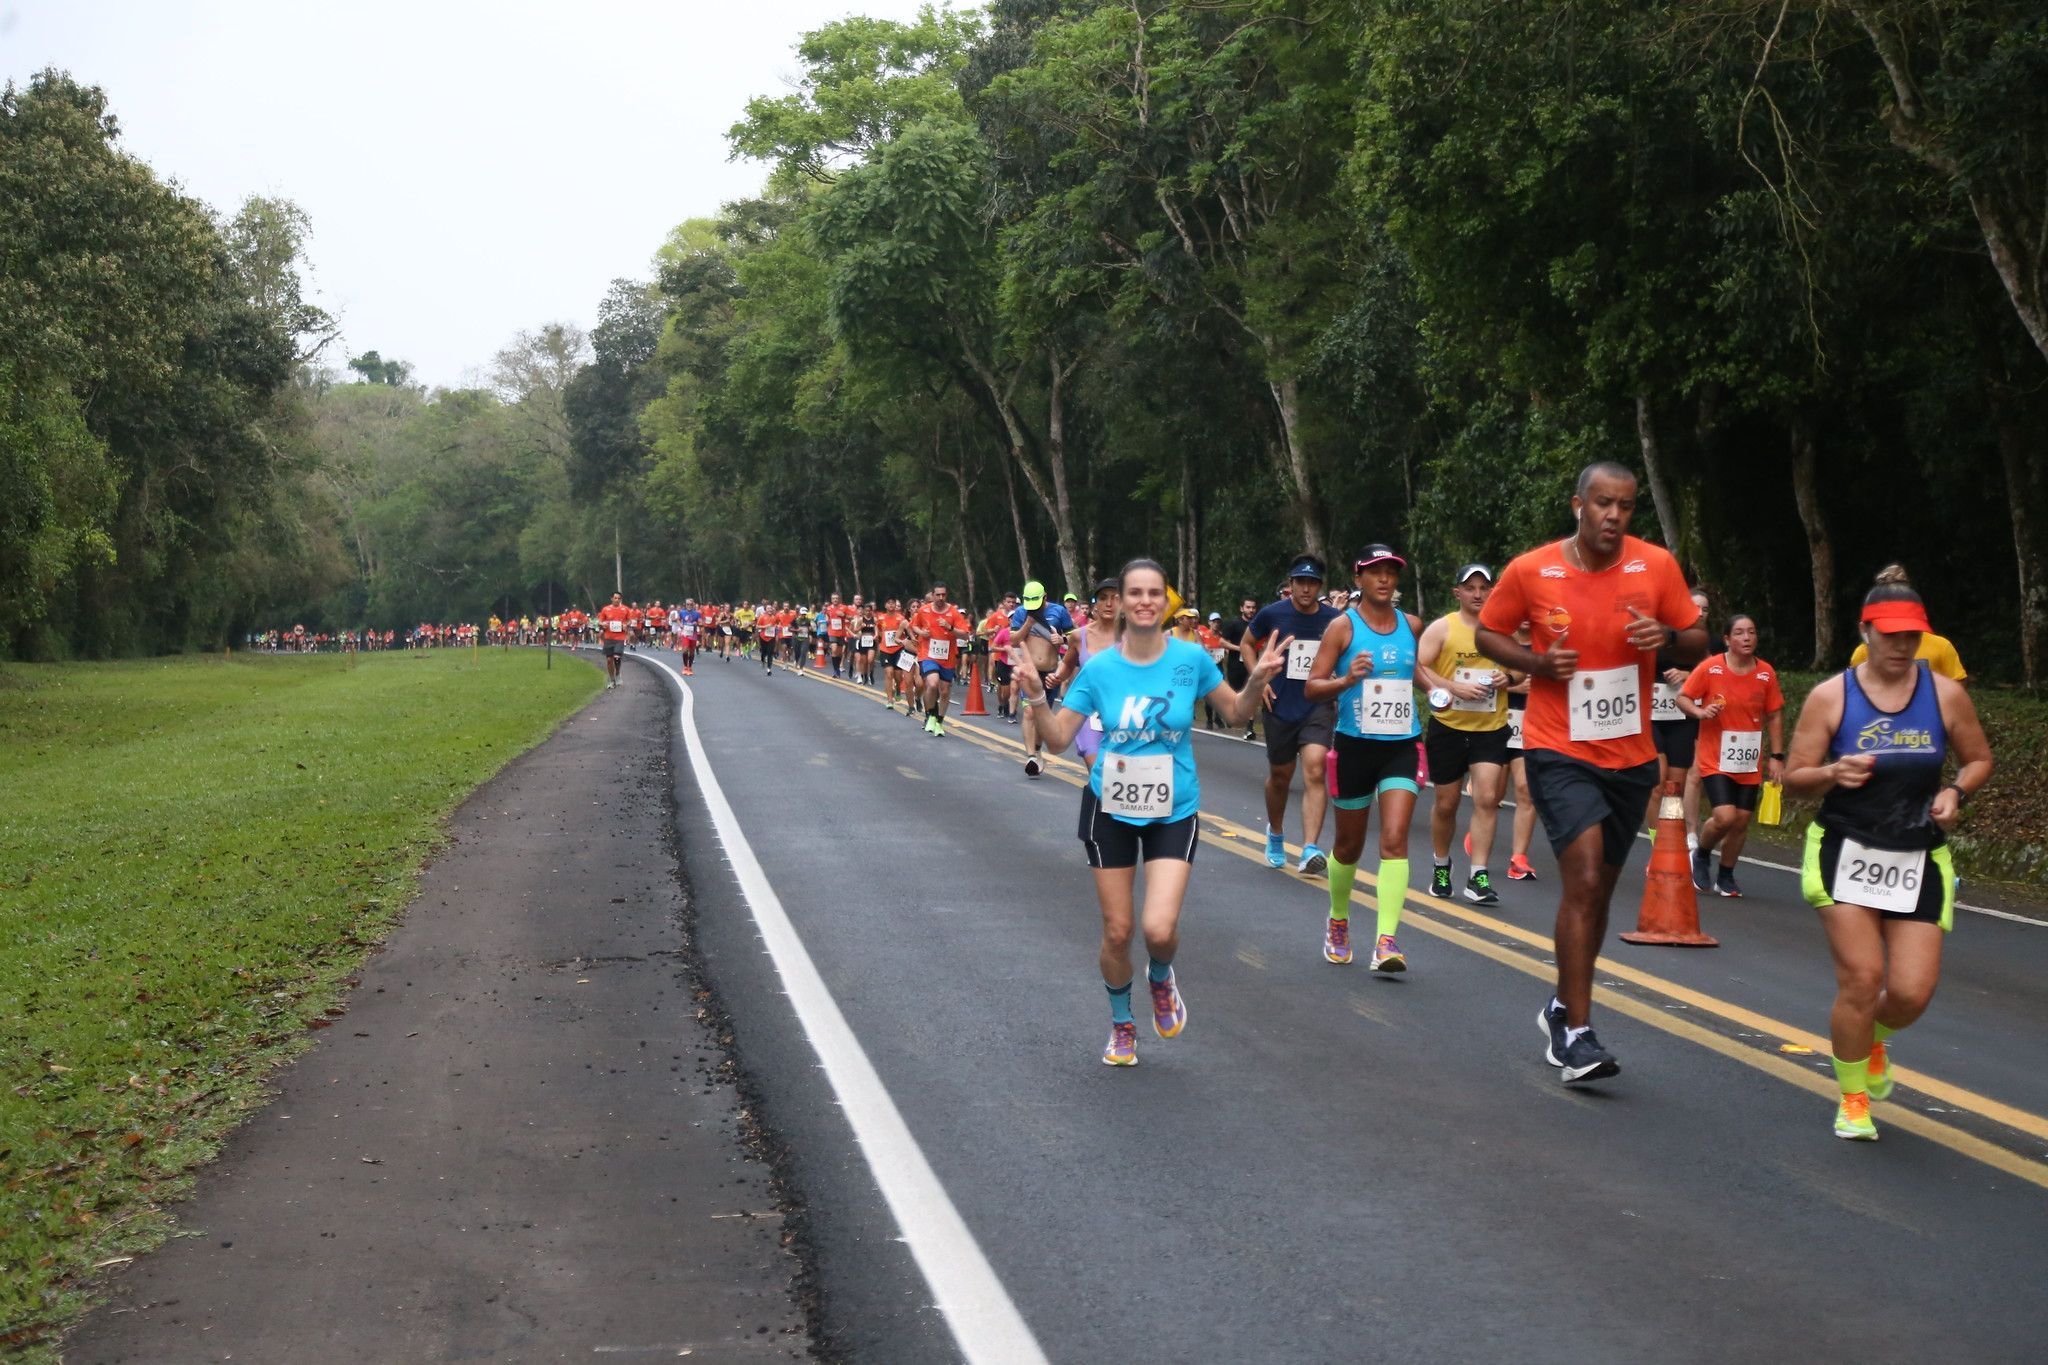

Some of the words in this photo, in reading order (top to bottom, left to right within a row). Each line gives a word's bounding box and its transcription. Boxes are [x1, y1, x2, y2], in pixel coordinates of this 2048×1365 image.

[1371, 702, 1411, 718] 2786
[1581, 693, 1637, 719] 1905
[1592, 717, 1623, 728] THIAGO
[1726, 748, 1759, 761] 2360
[1111, 781, 1171, 804] 2879
[1119, 802, 1156, 813] SAMARA
[1848, 859, 1919, 891] 2906
[1863, 885, 1893, 897] SILVIA
